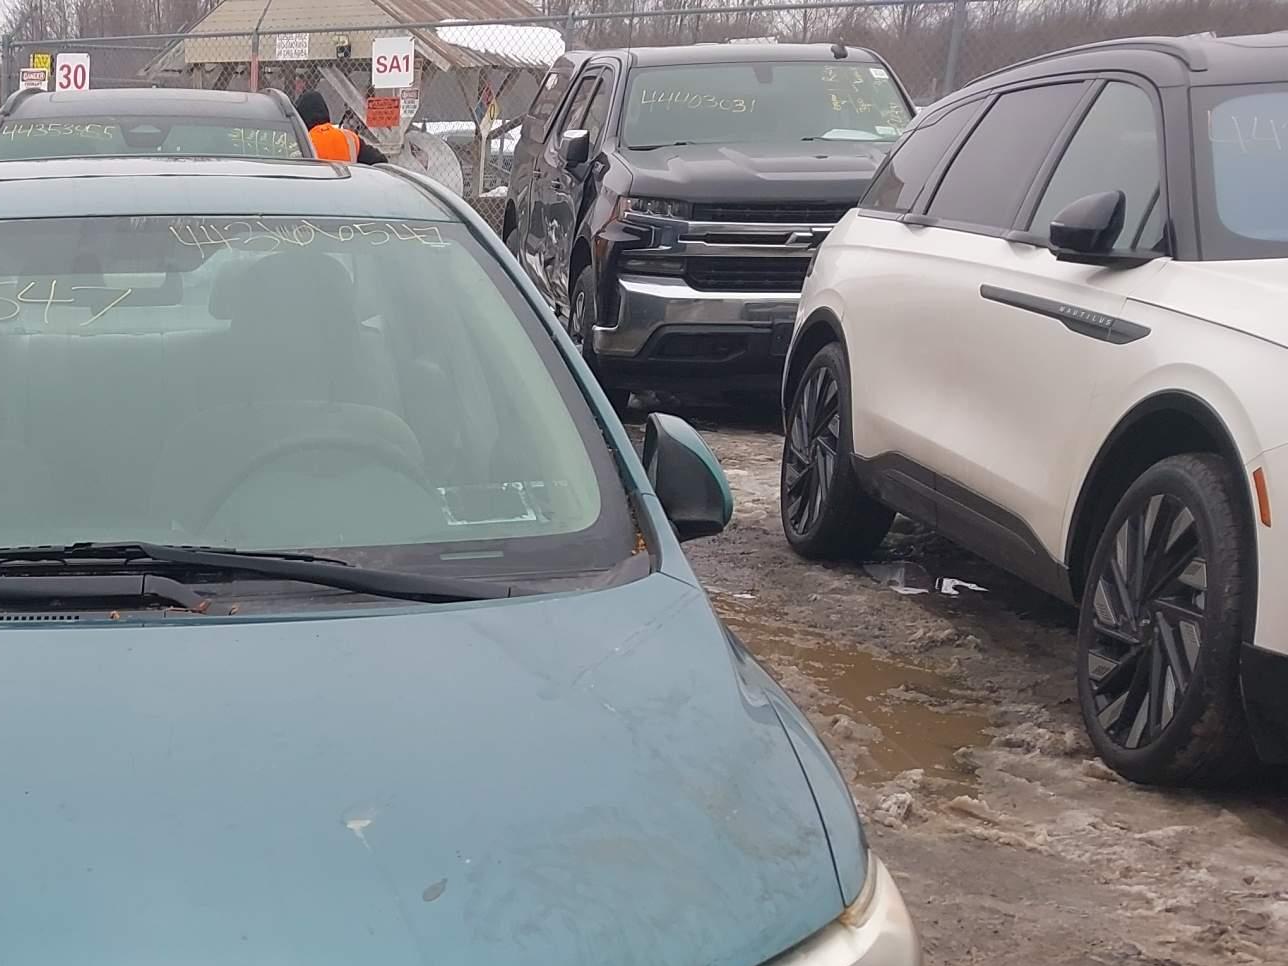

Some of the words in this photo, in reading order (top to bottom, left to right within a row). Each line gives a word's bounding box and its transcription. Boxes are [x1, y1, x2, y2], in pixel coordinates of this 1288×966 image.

[376, 54, 410, 73] SA1
[59, 64, 86, 90] 30
[1058, 305, 1112, 326] NAUTILUS
